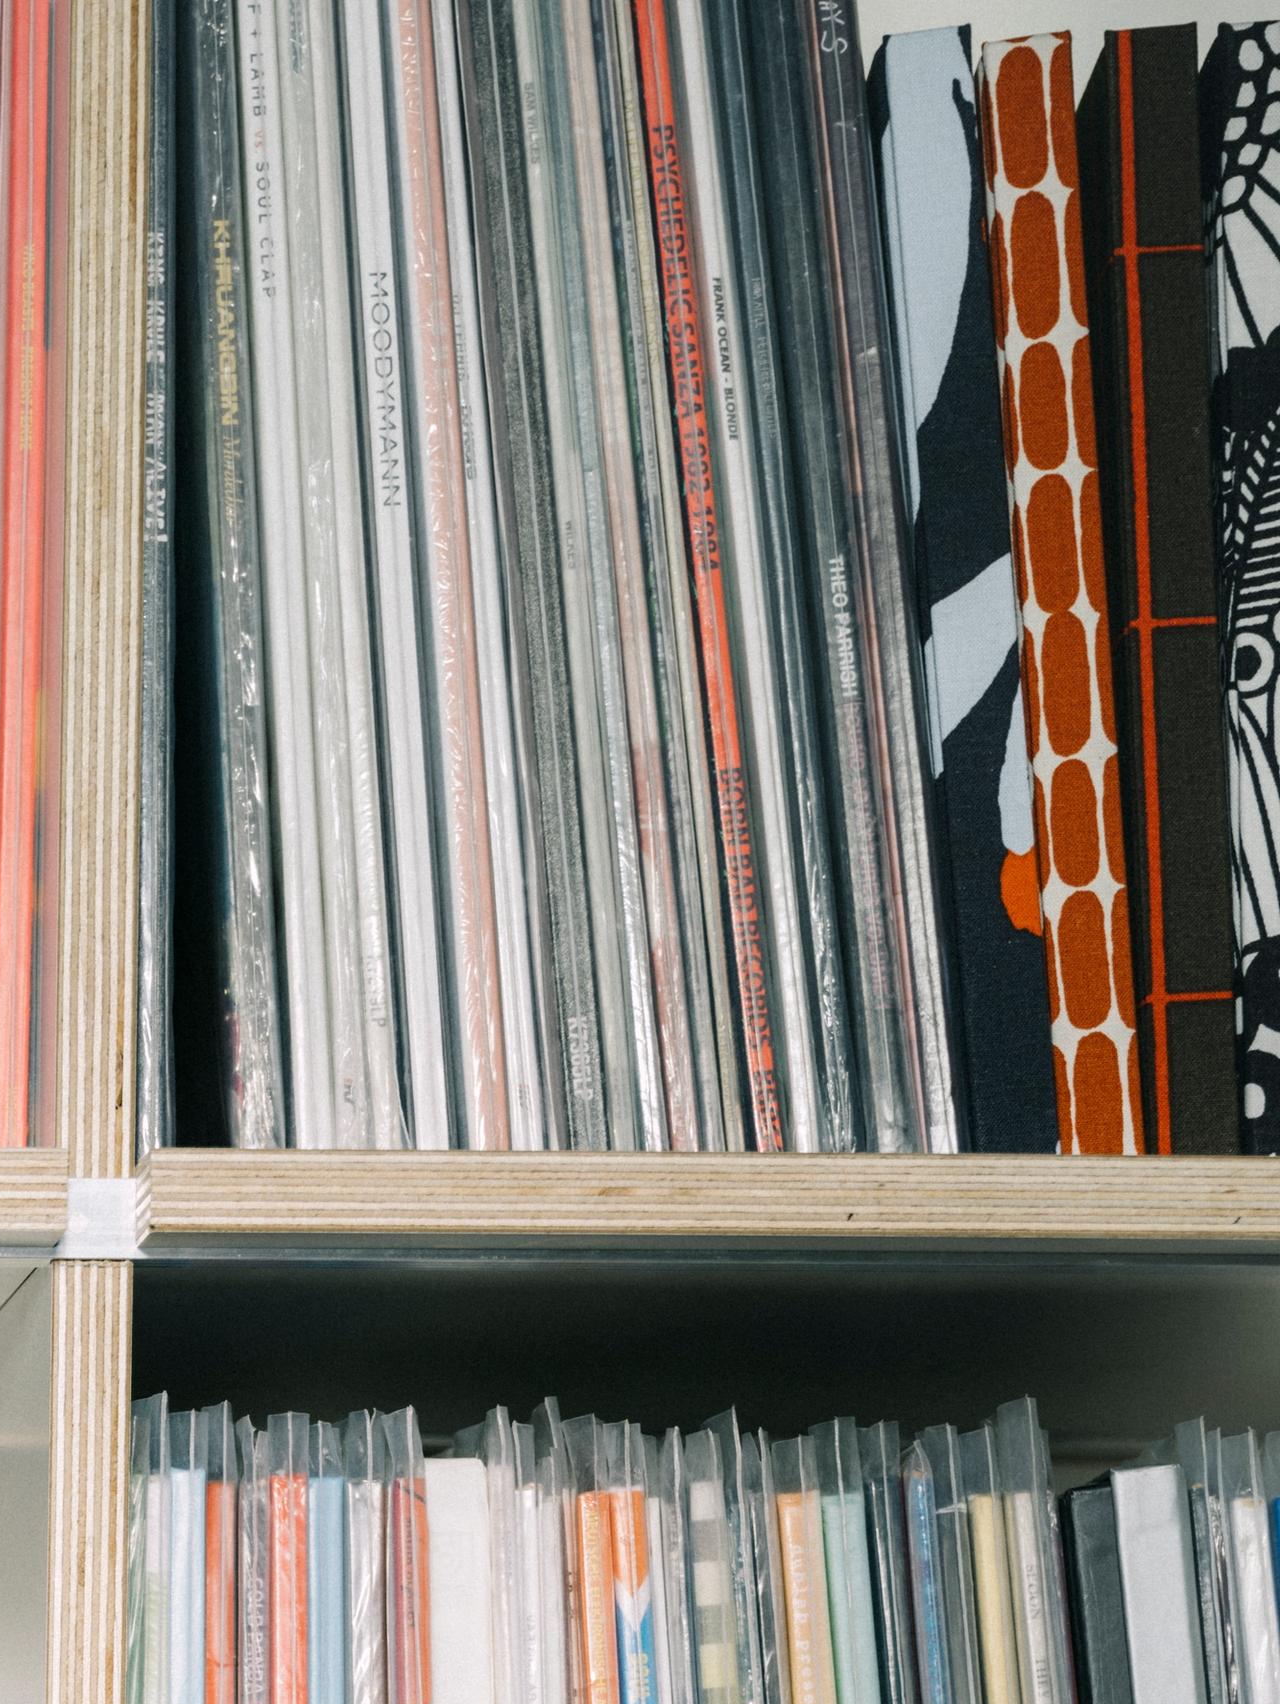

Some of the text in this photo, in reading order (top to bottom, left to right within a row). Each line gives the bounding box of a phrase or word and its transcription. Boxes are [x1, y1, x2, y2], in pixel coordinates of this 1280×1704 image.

[249, 52, 276, 300] LAMB SOUL CLAP
[653, 125, 703, 419] PSYCHEDELIC SANZA
[212, 219, 239, 426] KHRUANGBIN
[368, 272, 401, 507] MOODYMANN
[713, 277, 738, 441] FRANK OCEAN BLONDE
[827, 558, 859, 697] THEO PARRISH
